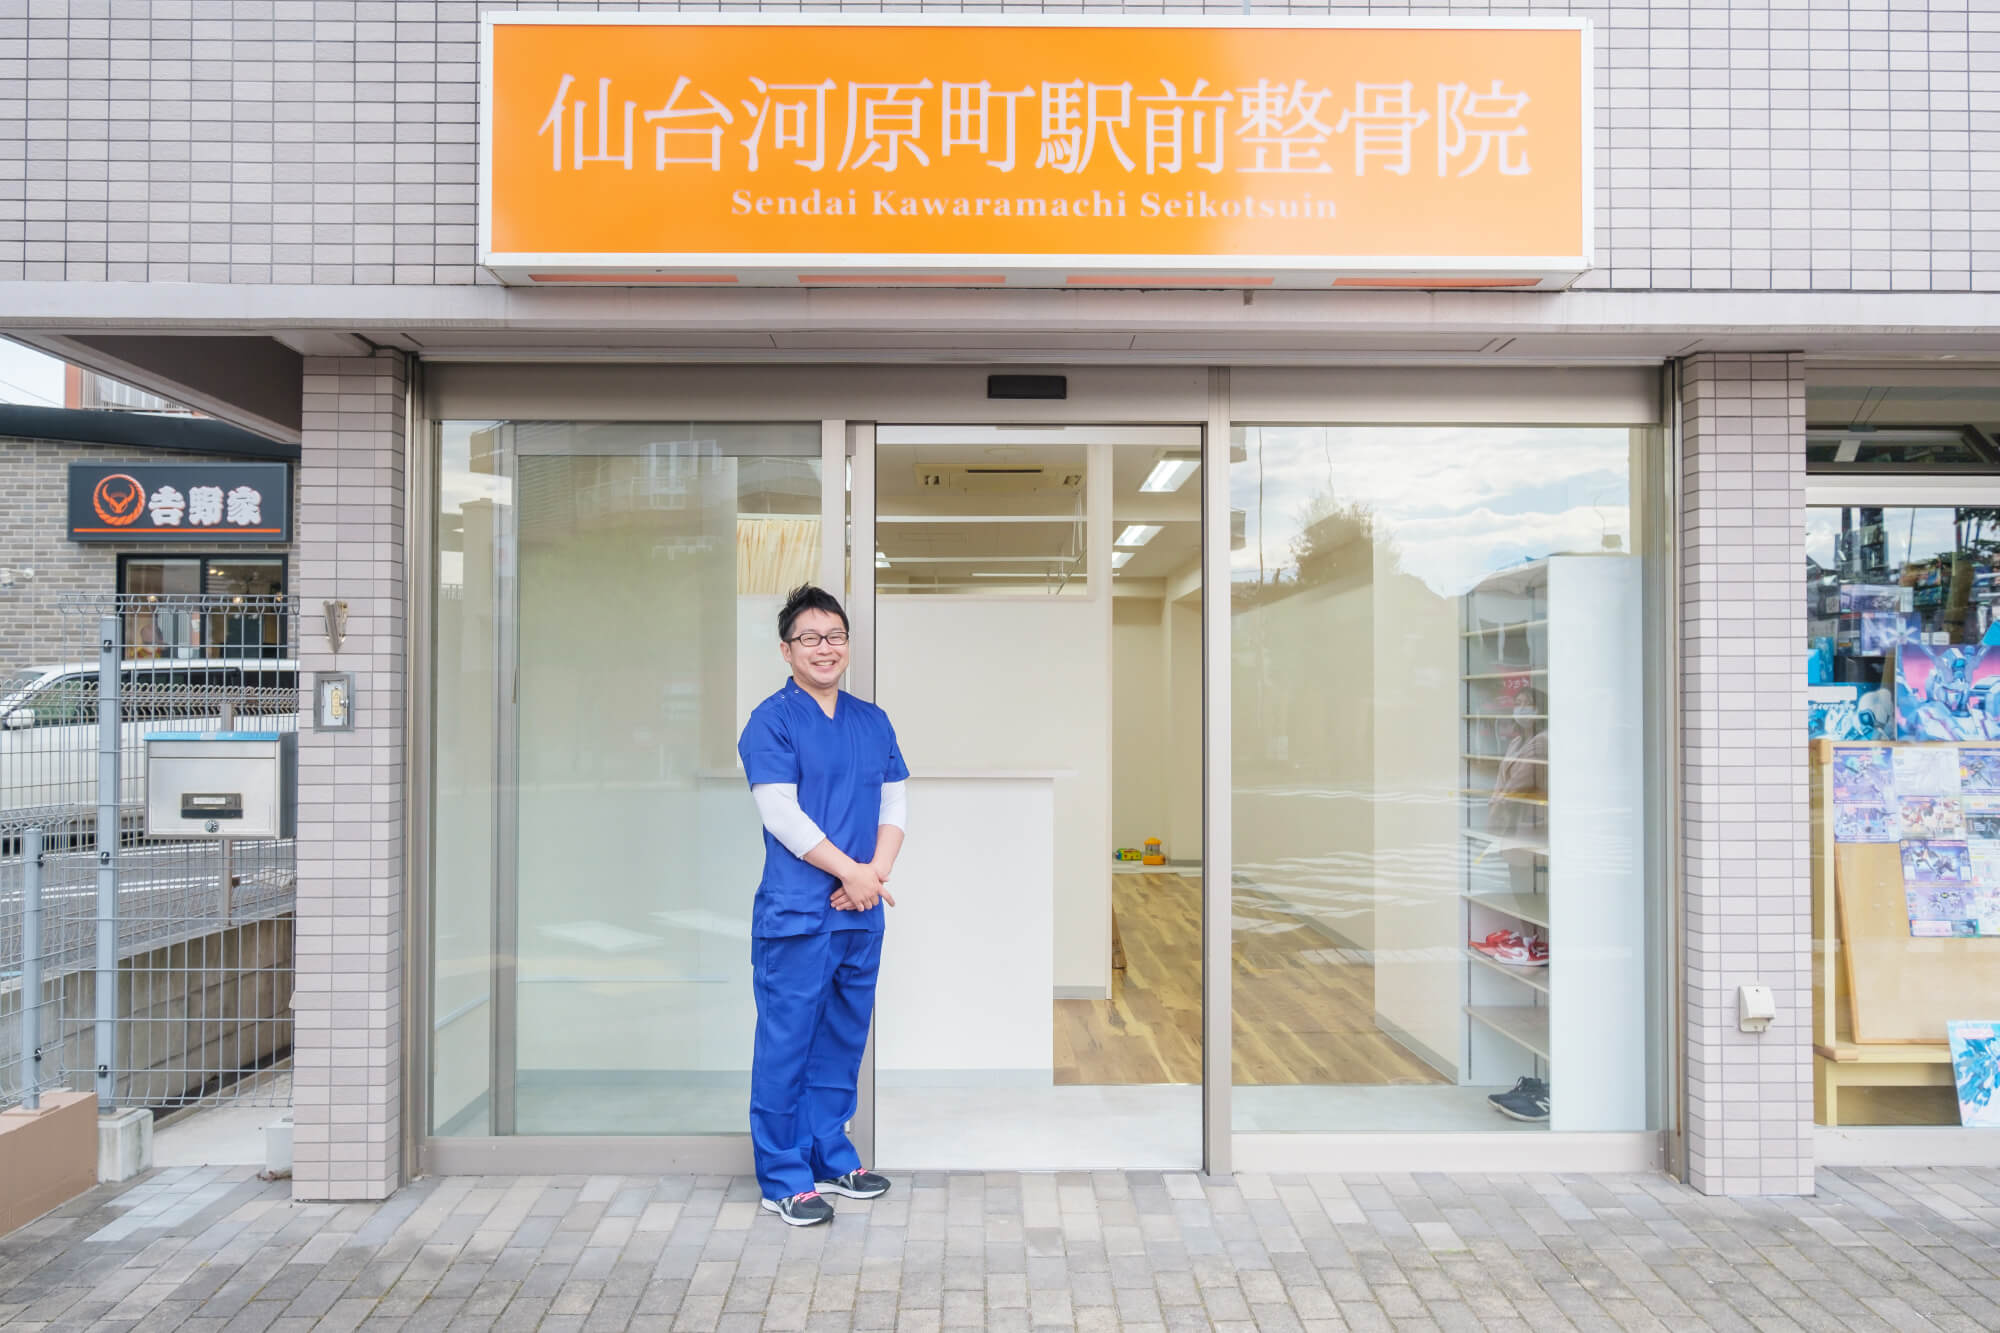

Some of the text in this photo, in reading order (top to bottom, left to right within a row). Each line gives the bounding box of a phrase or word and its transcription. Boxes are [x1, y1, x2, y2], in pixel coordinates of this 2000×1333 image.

[537, 73, 1532, 176] 仙台河原町駅前整骨院
[731, 189, 1338, 219] Sendai Kawaramachi Seikotsuin
